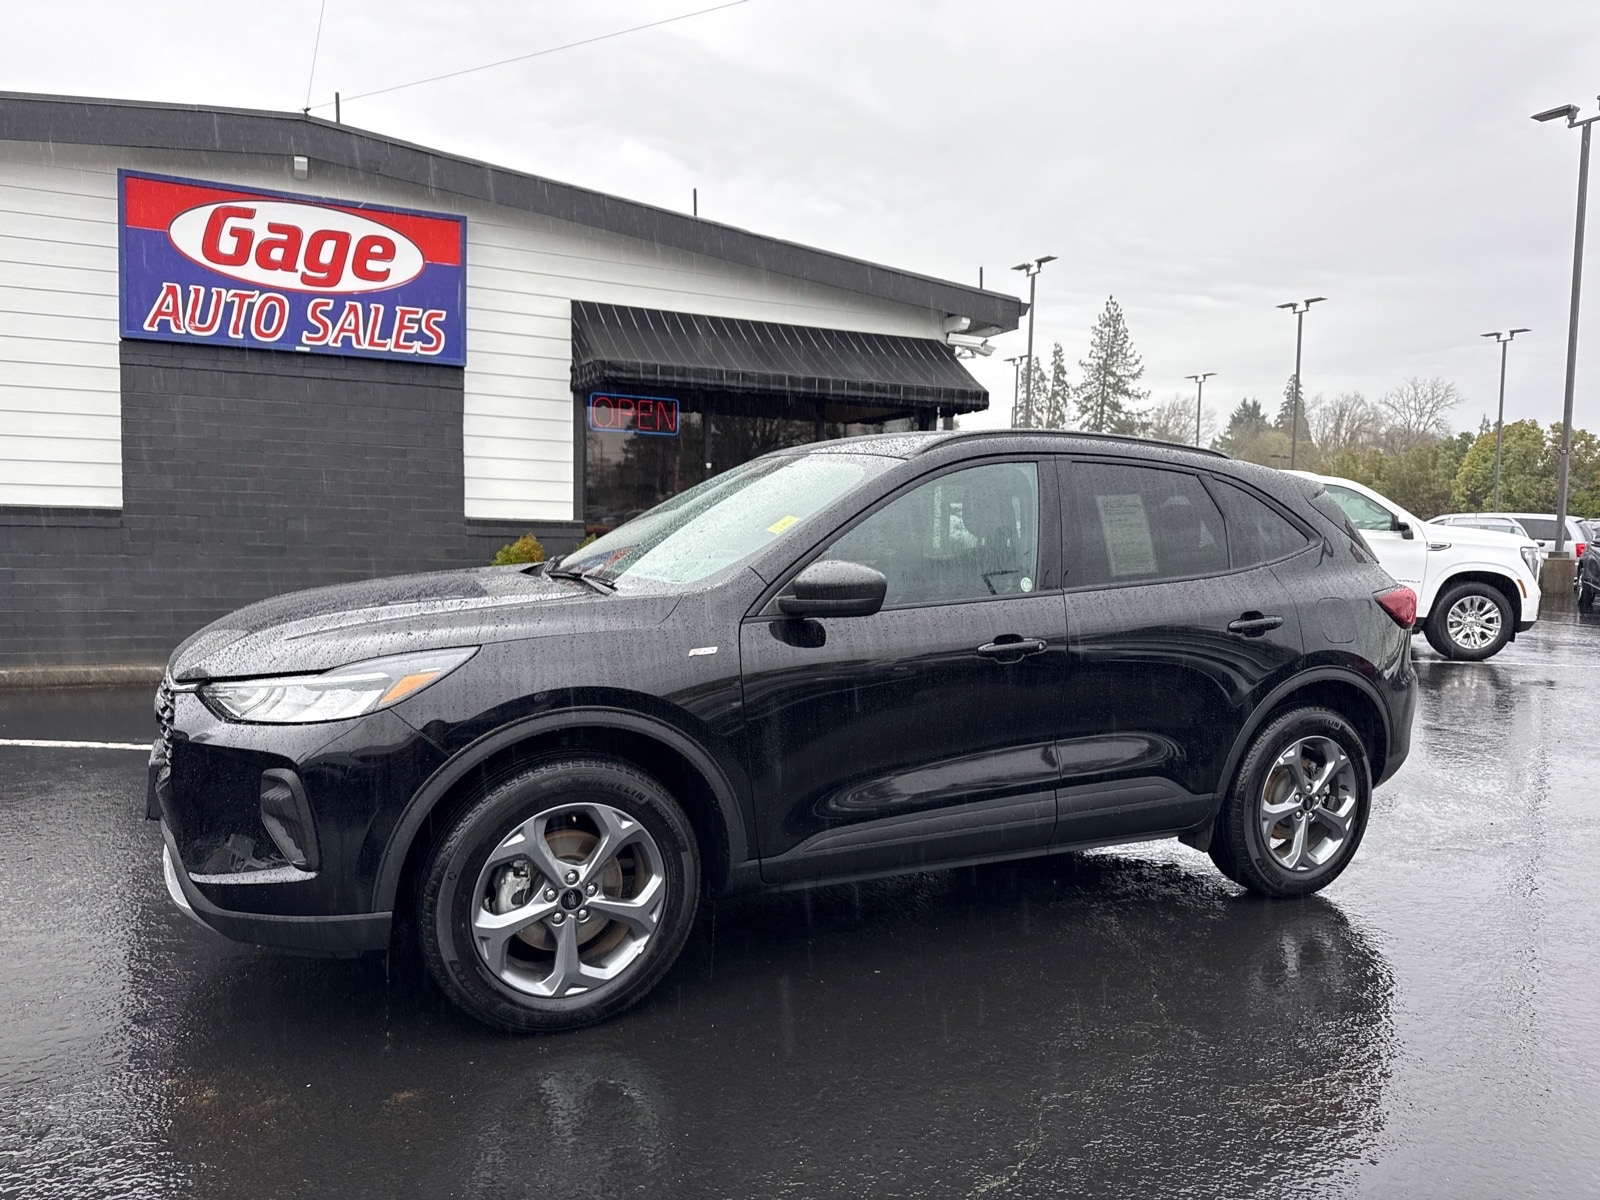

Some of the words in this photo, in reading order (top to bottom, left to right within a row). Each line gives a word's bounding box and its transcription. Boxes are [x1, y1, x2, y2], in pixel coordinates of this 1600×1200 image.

[201, 205, 396, 288] Gage
[143, 282, 290, 342] AUTO
[302, 298, 447, 355] SALES
[592, 396, 676, 431] OPEN
